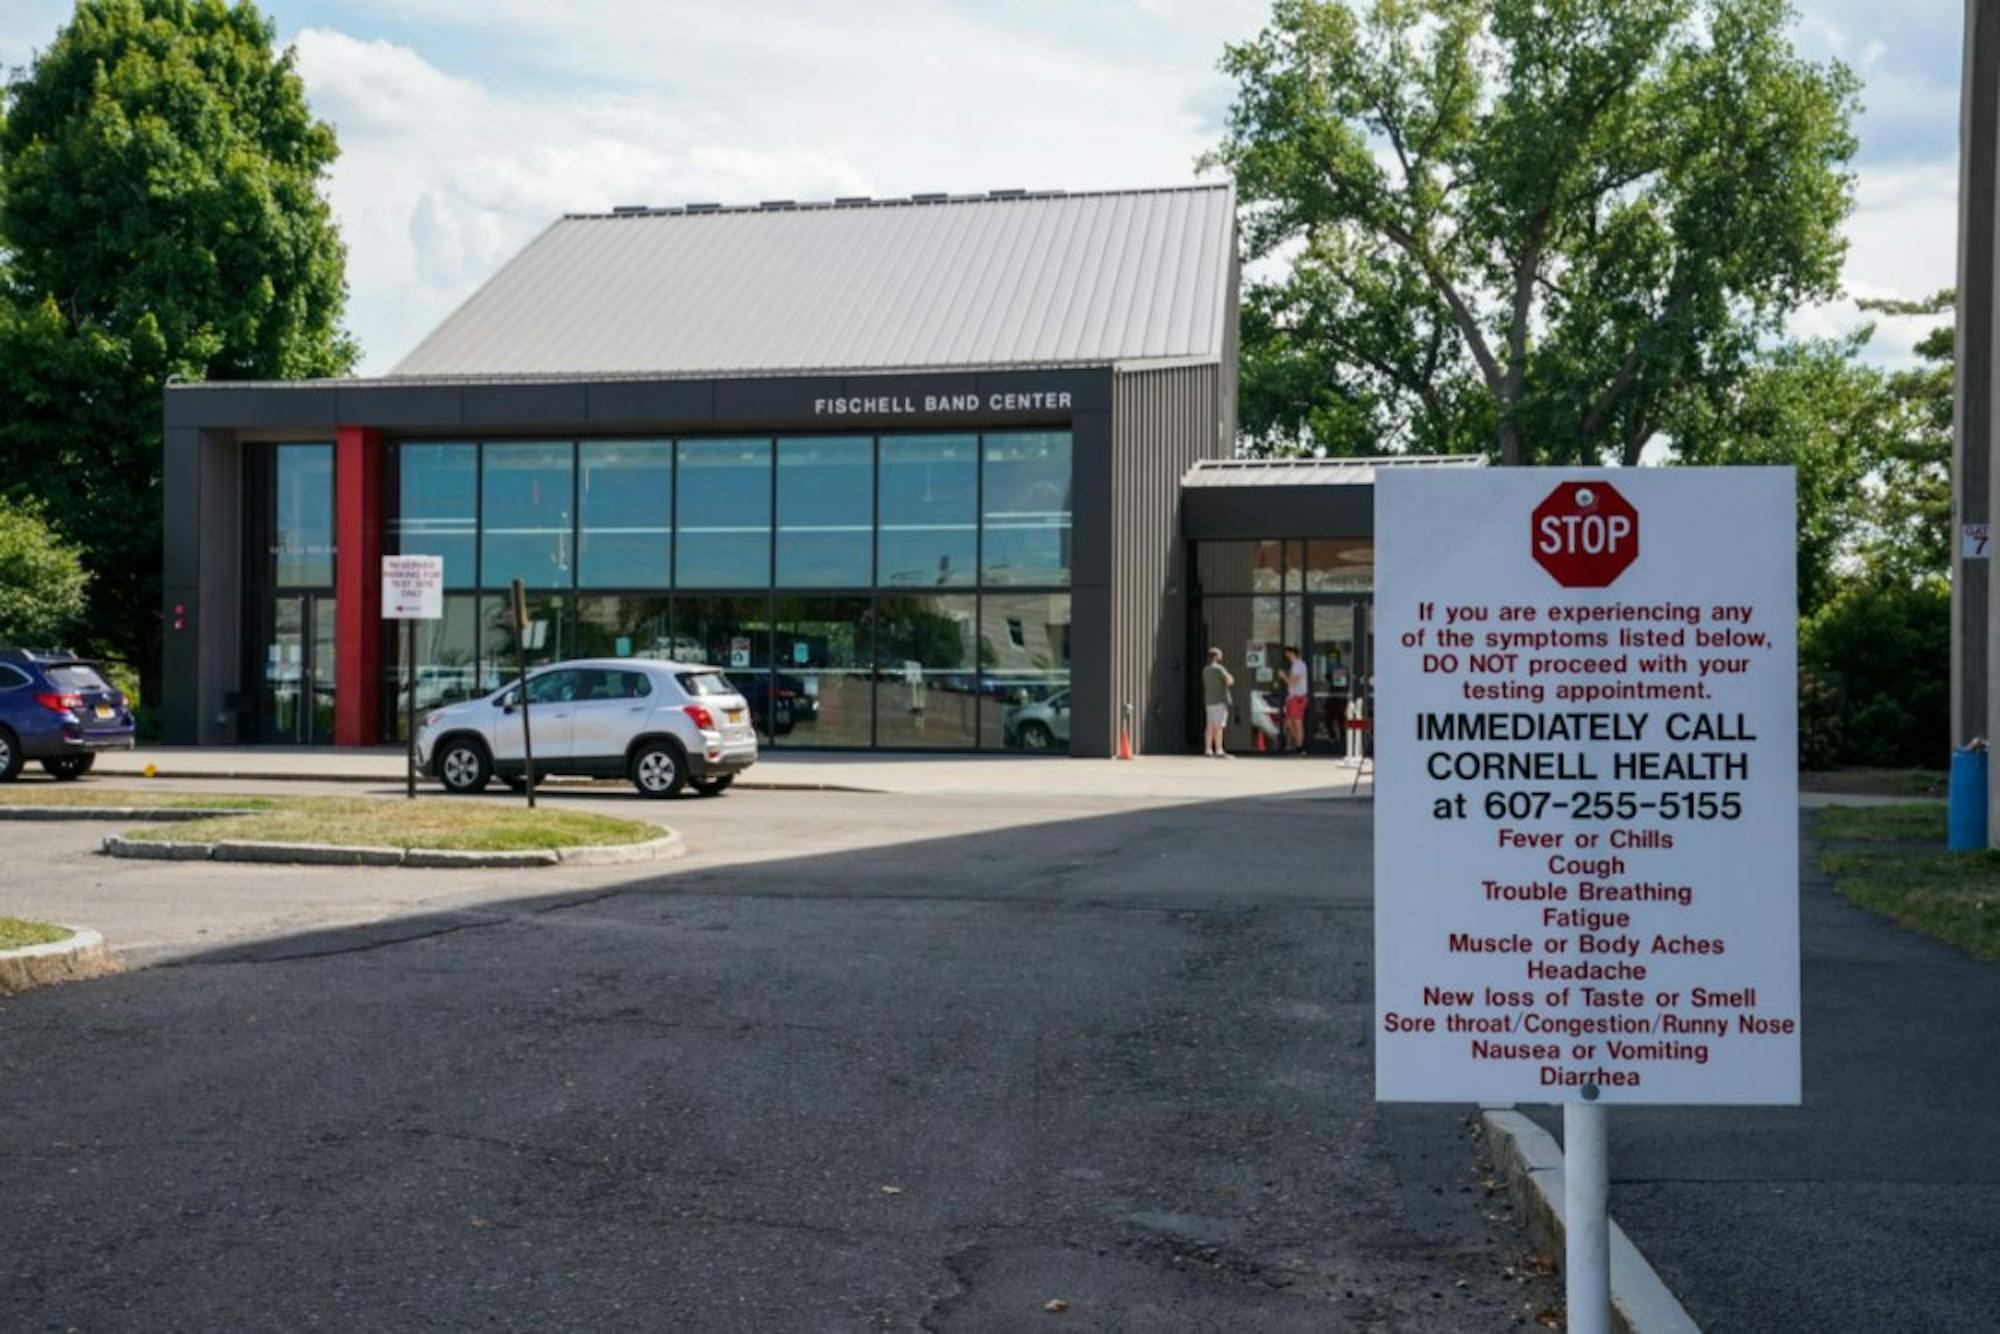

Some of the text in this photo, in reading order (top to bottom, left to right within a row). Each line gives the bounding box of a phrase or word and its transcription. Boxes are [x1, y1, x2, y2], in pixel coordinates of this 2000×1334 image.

[814, 392, 1072, 415] FISCHELL BAND CENTER
[1539, 515, 1631, 555] STOP
[1974, 535, 1989, 555] 7
[1418, 601, 1753, 625] If you are experiencing any
[1401, 627, 1772, 651] of the symptoms listed below,
[1422, 653, 1750, 678] DO NOT proceed with your
[1462, 680, 1712, 704] testing appointment.
[1416, 712, 1757, 742] IMMEDIATELY CALL
[1426, 751, 1749, 781] CORNELL HEALTH
[1432, 791, 1743, 821] at 607-255-5155
[1498, 828, 1674, 849] Fever or Chills
[1548, 854, 1625, 880] Cough
[1481, 880, 1693, 907] Trouble Breathing
[1543, 907, 1631, 932] Fatigue
[1448, 932, 1725, 958] Muscle or Body Aches
[1527, 959, 1647, 981] Headache
[1423, 986, 1756, 1008] New loss of Taste or Smell
[1383, 1011, 1436, 1033] Sore
[1738, 1014, 1795, 1035] Nose
[1471, 1039, 1709, 1065] Nausea or Vomiting
[1540, 1065, 1641, 1086] Diarrhea
